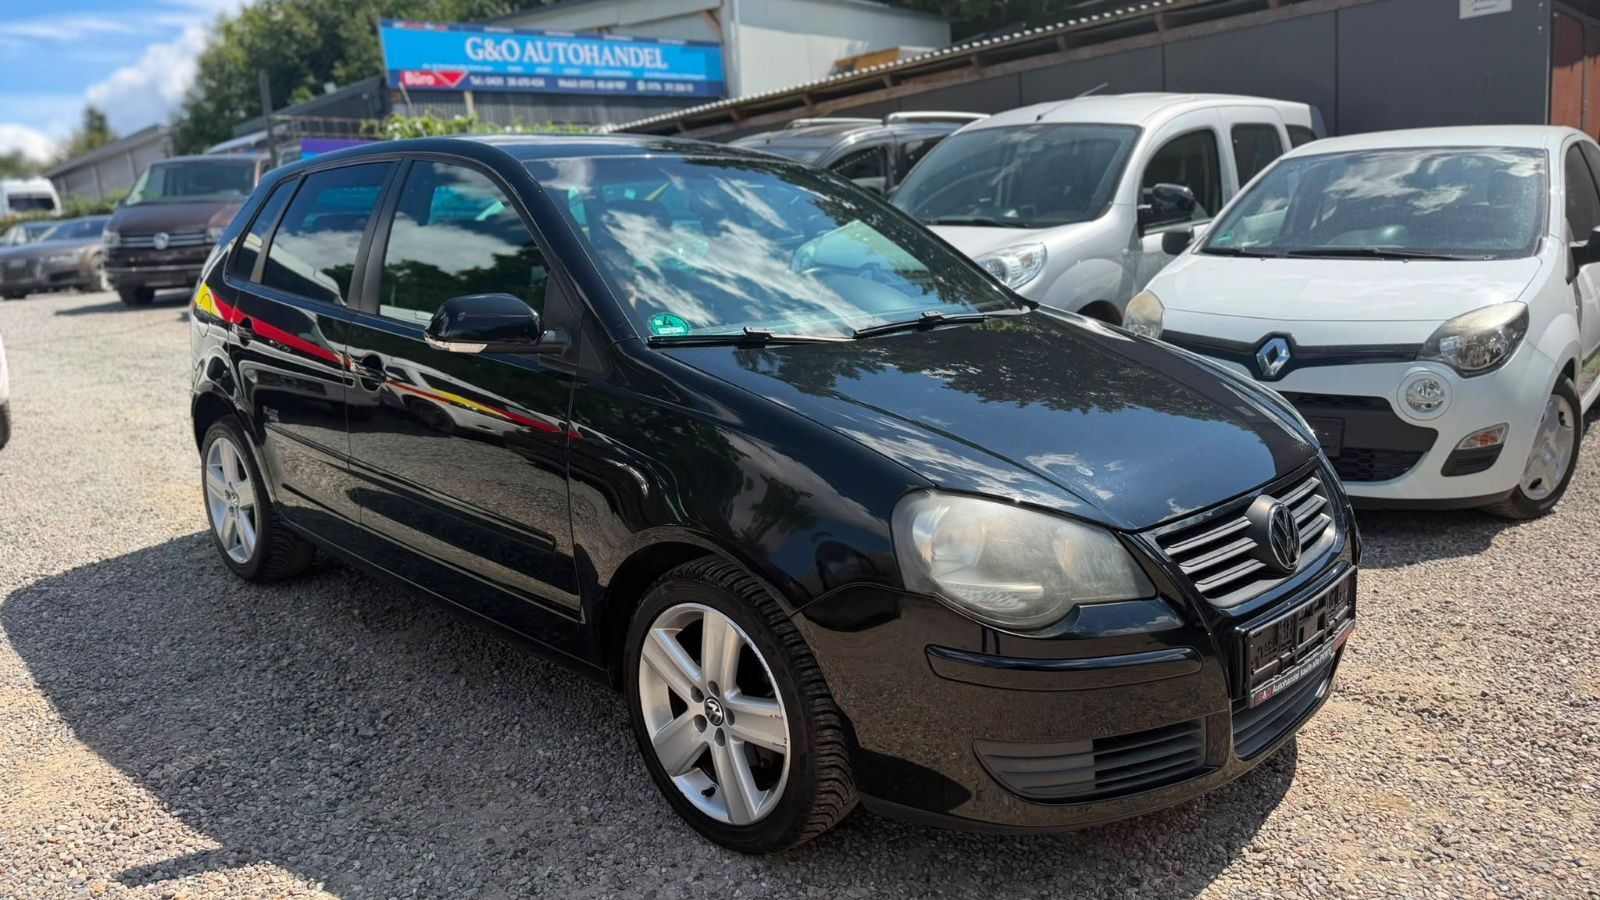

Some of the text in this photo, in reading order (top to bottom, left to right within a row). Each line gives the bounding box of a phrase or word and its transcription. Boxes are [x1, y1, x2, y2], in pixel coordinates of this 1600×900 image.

[465, 36, 668, 69] G&O AUTOHANDEL
[403, 71, 436, 86] Büro
[1272, 671, 1300, 693] Autohandel
